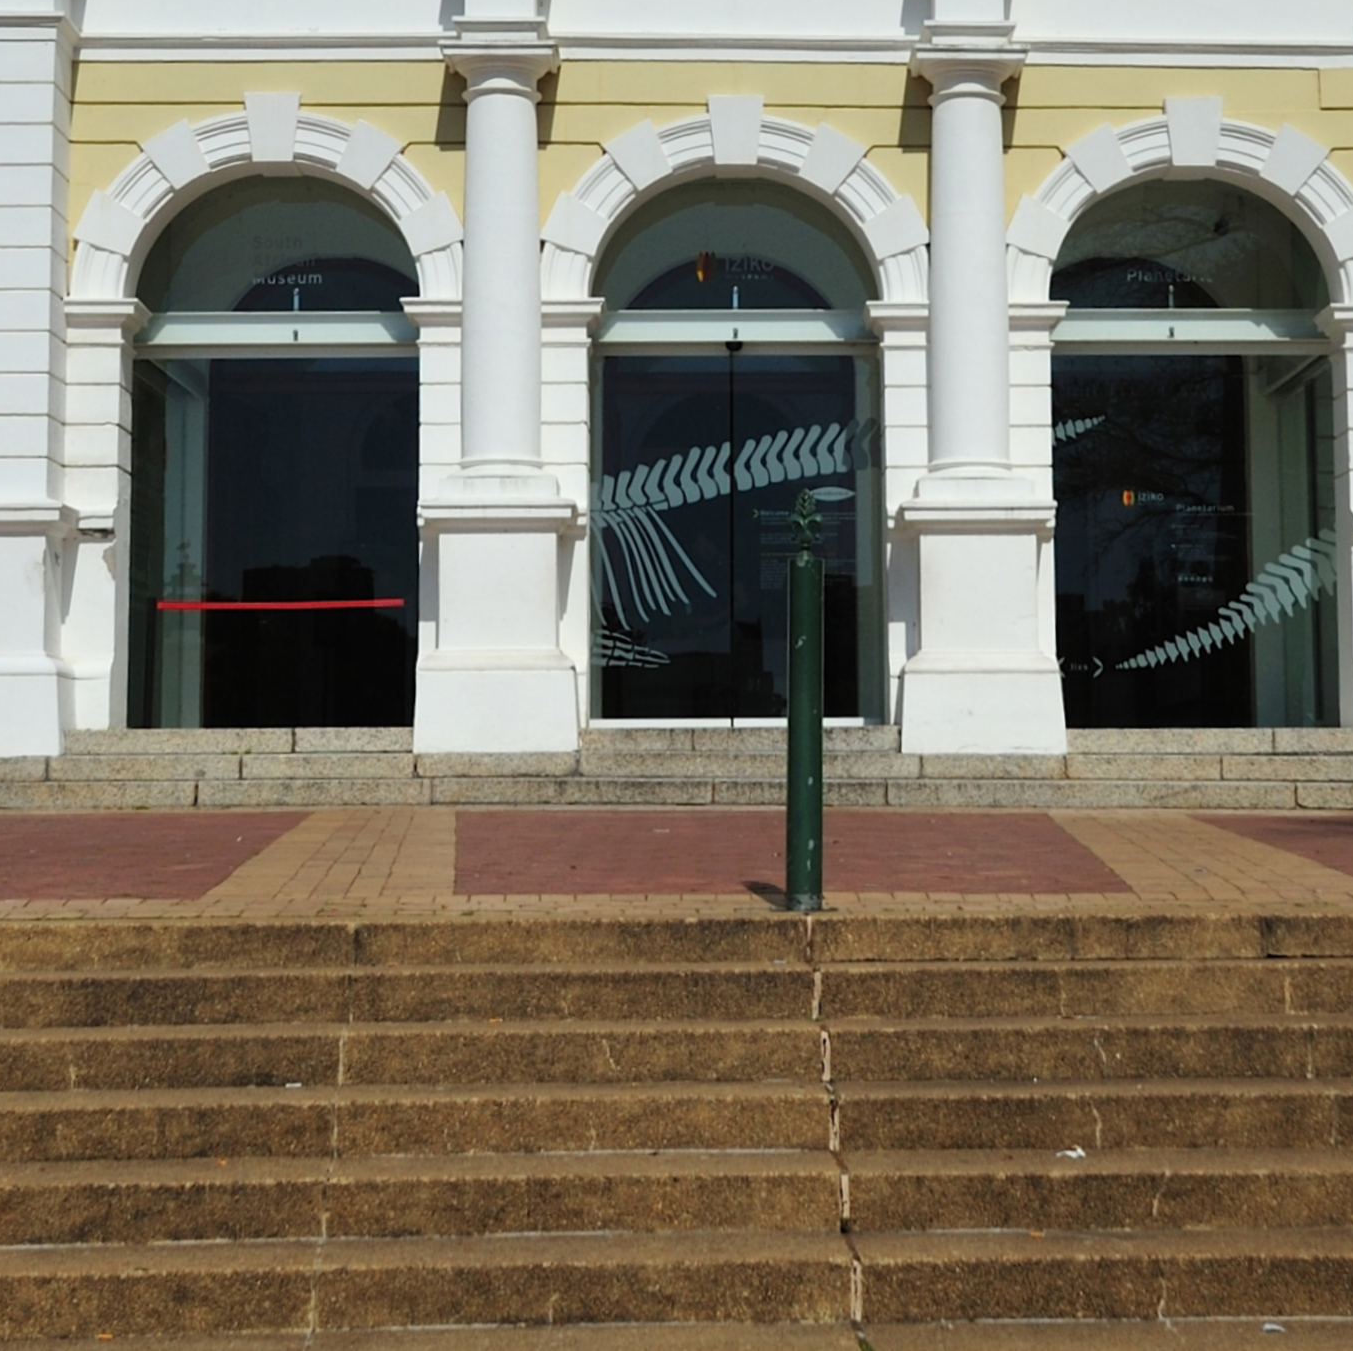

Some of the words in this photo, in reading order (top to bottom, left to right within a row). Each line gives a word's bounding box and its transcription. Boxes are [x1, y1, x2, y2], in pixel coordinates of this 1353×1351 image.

[253, 235, 302, 249] South
[252, 270, 322, 285] Museum
[1127, 268, 1214, 282] Planetar
